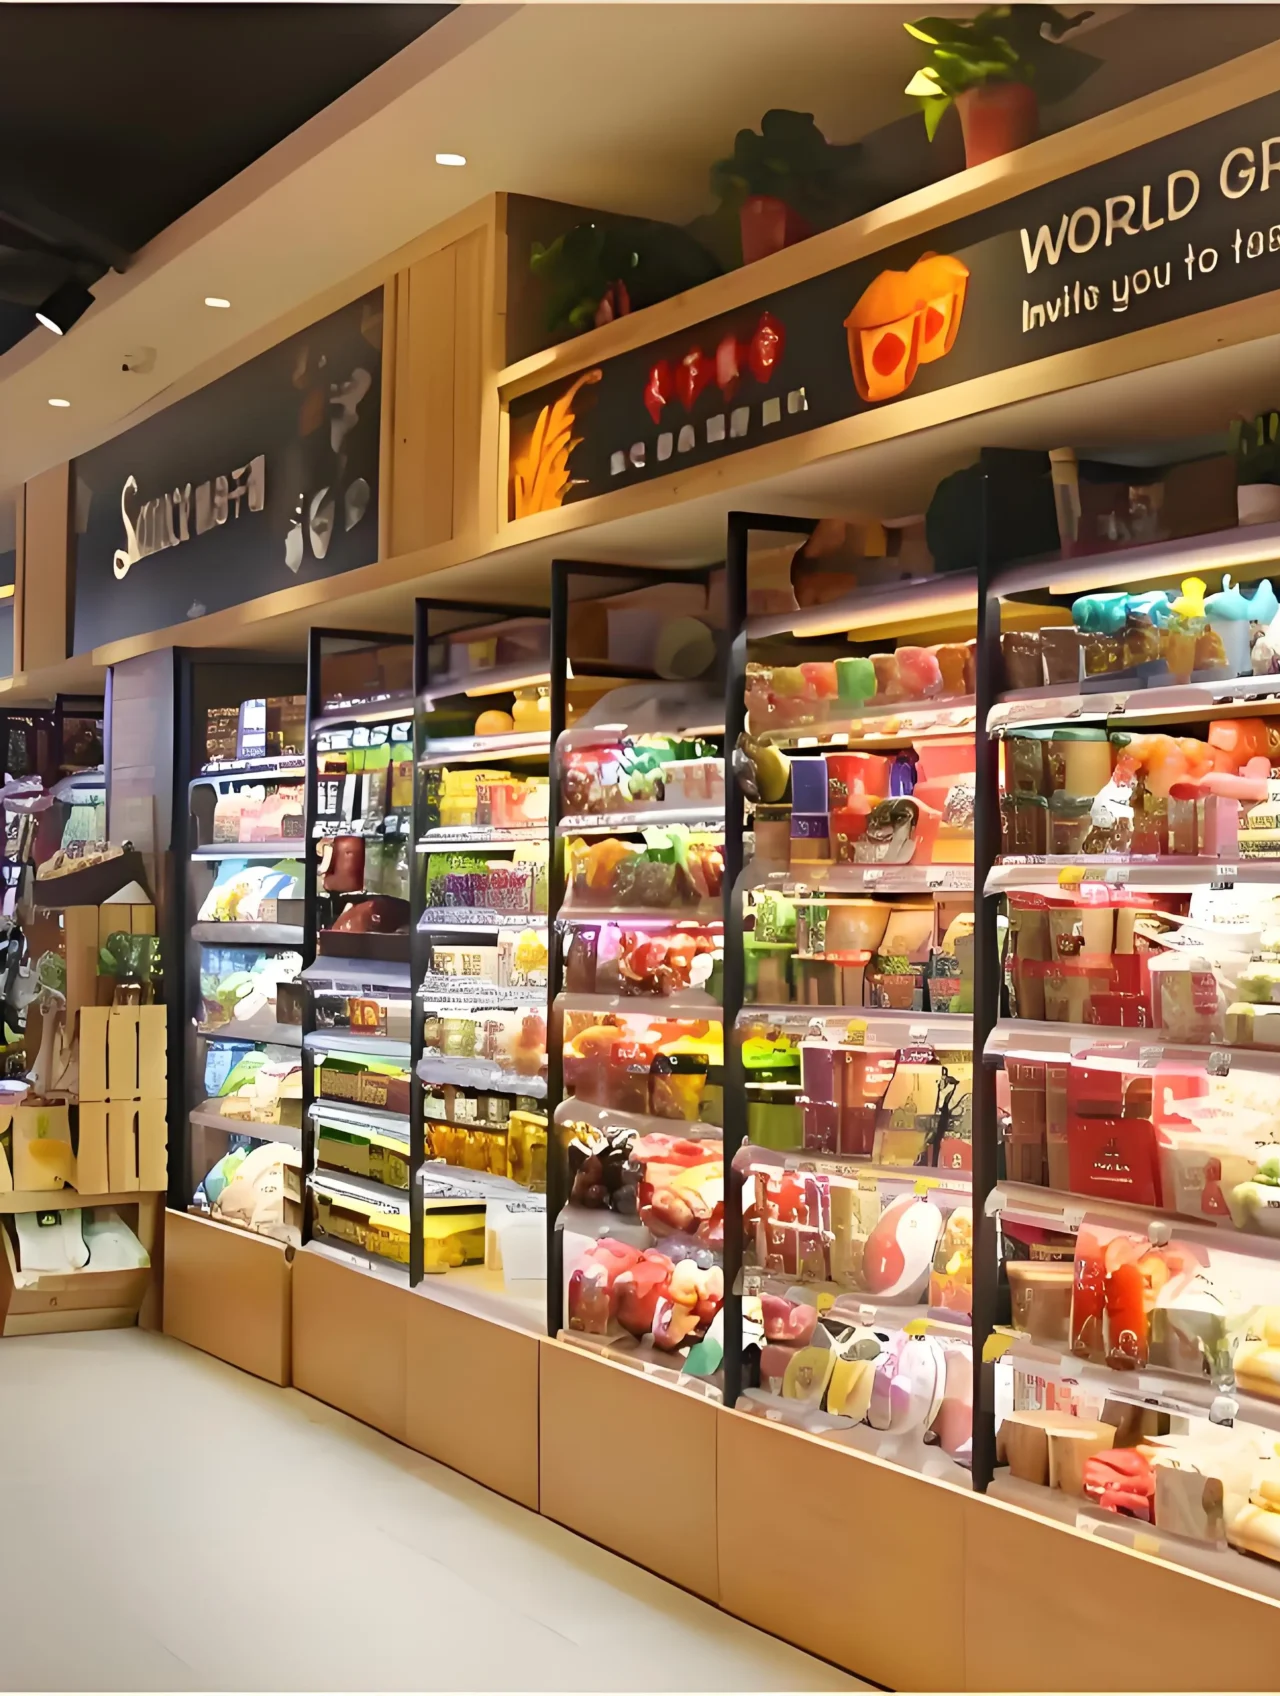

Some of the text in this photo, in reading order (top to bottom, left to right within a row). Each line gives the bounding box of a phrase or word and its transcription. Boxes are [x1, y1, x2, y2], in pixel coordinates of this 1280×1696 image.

[1020, 169, 1200, 274] WORLD
[1112, 262, 1171, 313] you
[1184, 243, 1218, 281] to
